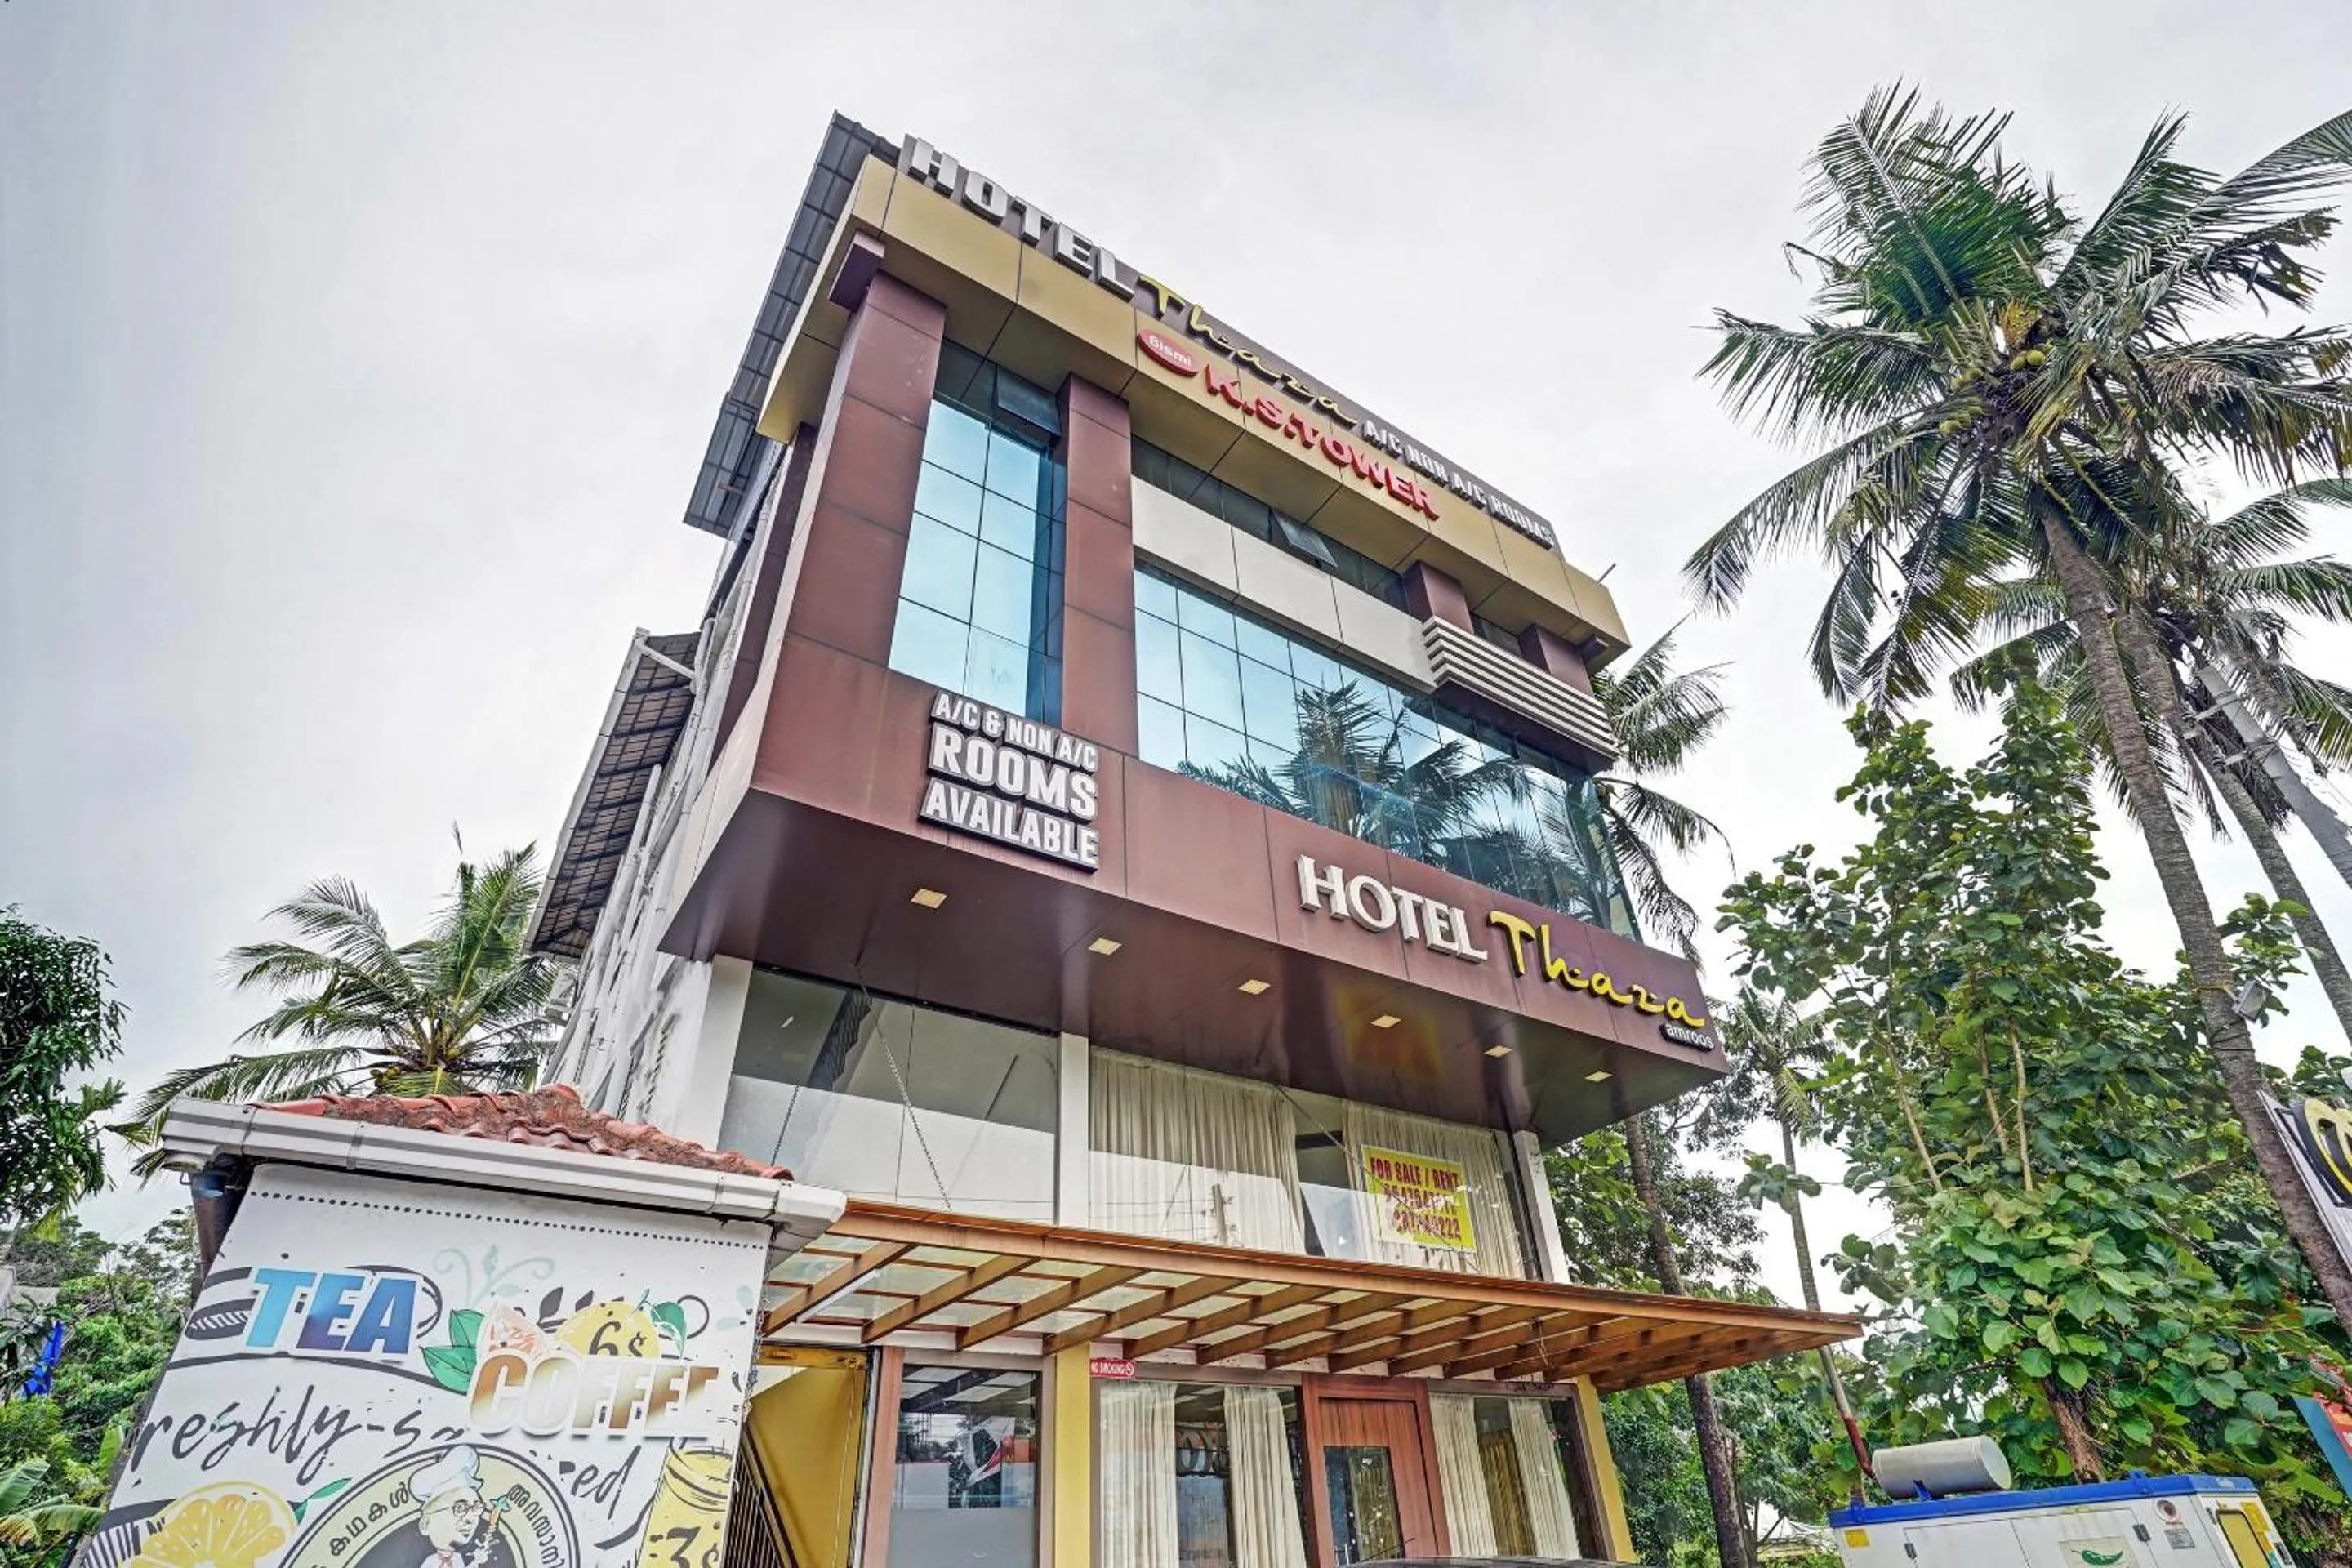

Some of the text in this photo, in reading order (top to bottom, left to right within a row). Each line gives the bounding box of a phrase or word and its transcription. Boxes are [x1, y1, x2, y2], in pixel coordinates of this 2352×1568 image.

[907, 136, 1134, 301] HOTEL
[1363, 420, 1403, 458] A/C
[1405, 444, 1448, 488] NON
[1450, 471, 1487, 510] A/C
[1487, 494, 1554, 550] ROOMS
[931, 725, 1098, 819] ROOMS
[933, 693, 1098, 772] A/C & NON A/C
[922, 781, 1098, 866] AVAILABLE
[1295, 855, 1489, 964] HOTEL
[1664, 1022, 1714, 1049] amroos
[1370, 1156, 1392, 1181] FOR
[1395, 1160, 1421, 1185] SALE
[1432, 1169, 1459, 1191] RENT
[245, 1267, 416, 1354] TEA
